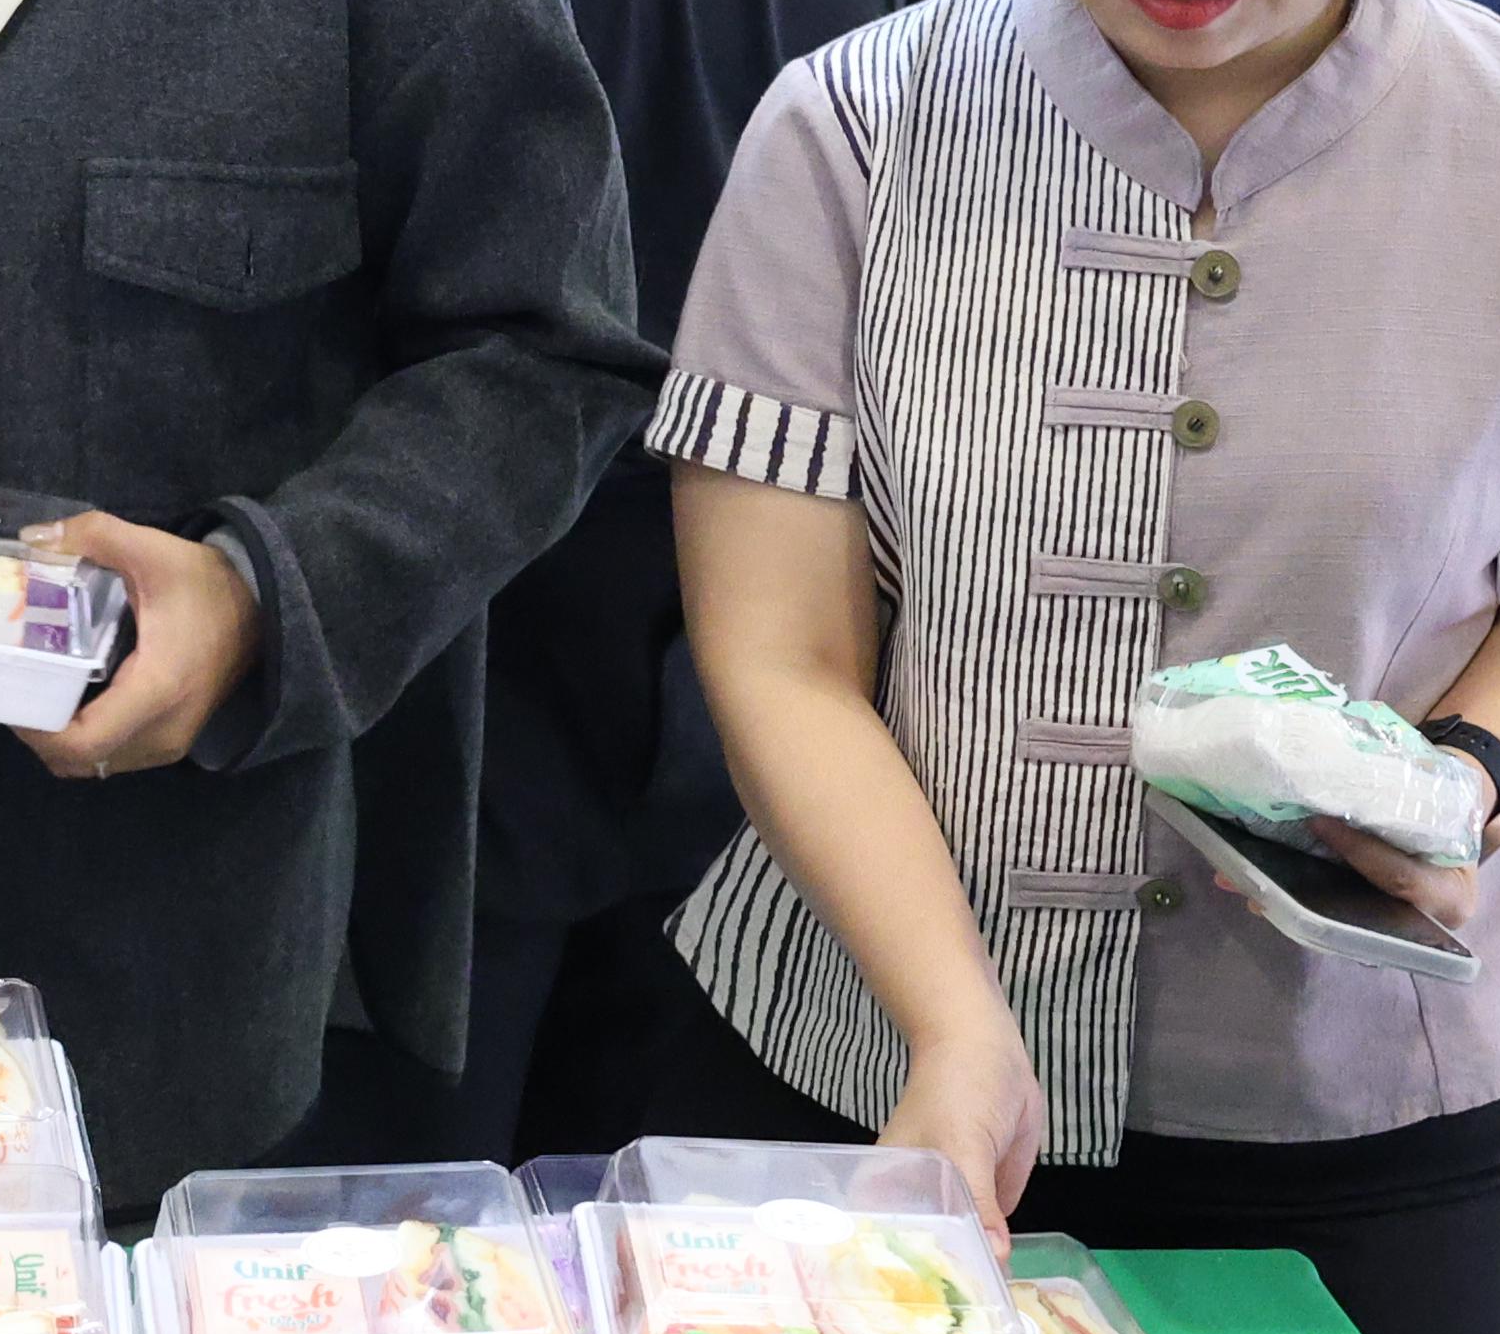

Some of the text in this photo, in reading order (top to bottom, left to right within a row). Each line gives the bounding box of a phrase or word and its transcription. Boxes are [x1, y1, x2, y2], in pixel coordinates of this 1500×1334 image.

[666, 1231, 743, 1251] Unif
[234, 1259, 312, 1281] Unif
[221, 1282, 343, 1317] fresh
